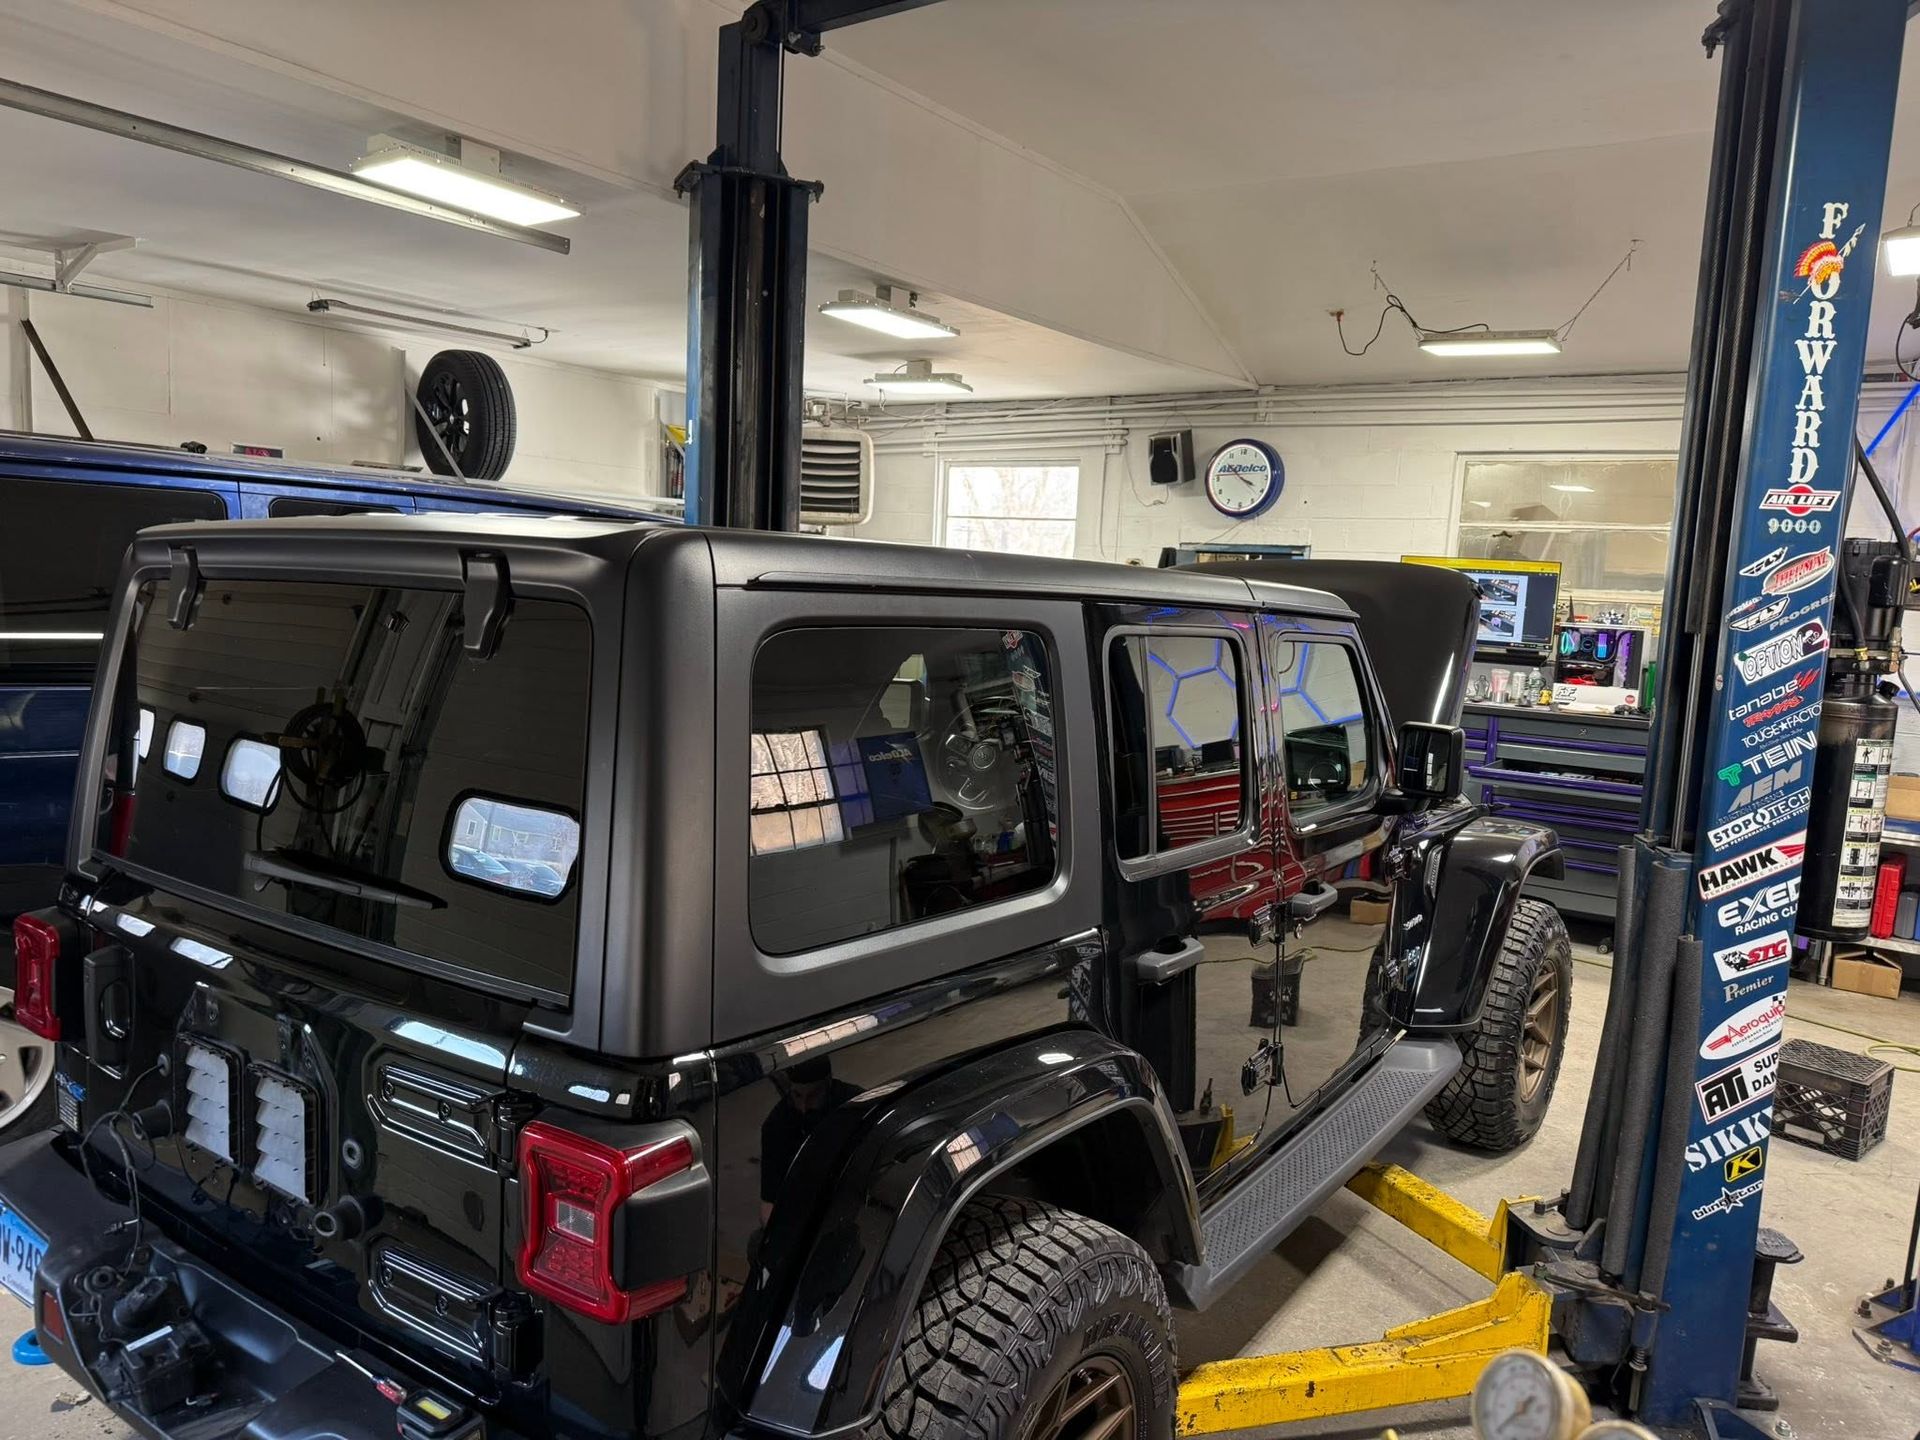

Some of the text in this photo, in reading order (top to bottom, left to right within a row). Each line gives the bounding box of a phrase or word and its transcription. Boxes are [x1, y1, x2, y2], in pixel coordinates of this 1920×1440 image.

[1786, 202, 1849, 484] FORWARD
[1766, 494, 1832, 506] AIR LIFT
[1767, 518, 1822, 535] 9000
[1728, 678, 1799, 721] tanabe
[1741, 724, 1780, 748] TOUGE
[1786, 701, 1822, 728] FACTO
[1742, 730, 1818, 775] TEIN
[1727, 760, 1802, 813] AEM
[1731, 824, 1771, 845] PERFORMANCE
[1792, 807, 1809, 817] SYSTE
[1700, 847, 1778, 892] HAWK
[1735, 912, 1779, 936] RACING
[1746, 938, 1788, 965] STG
[1723, 975, 1774, 1003] Premier
[1726, 1004, 1786, 1043] Aeroquip
[1701, 1066, 1750, 1118] ATI
